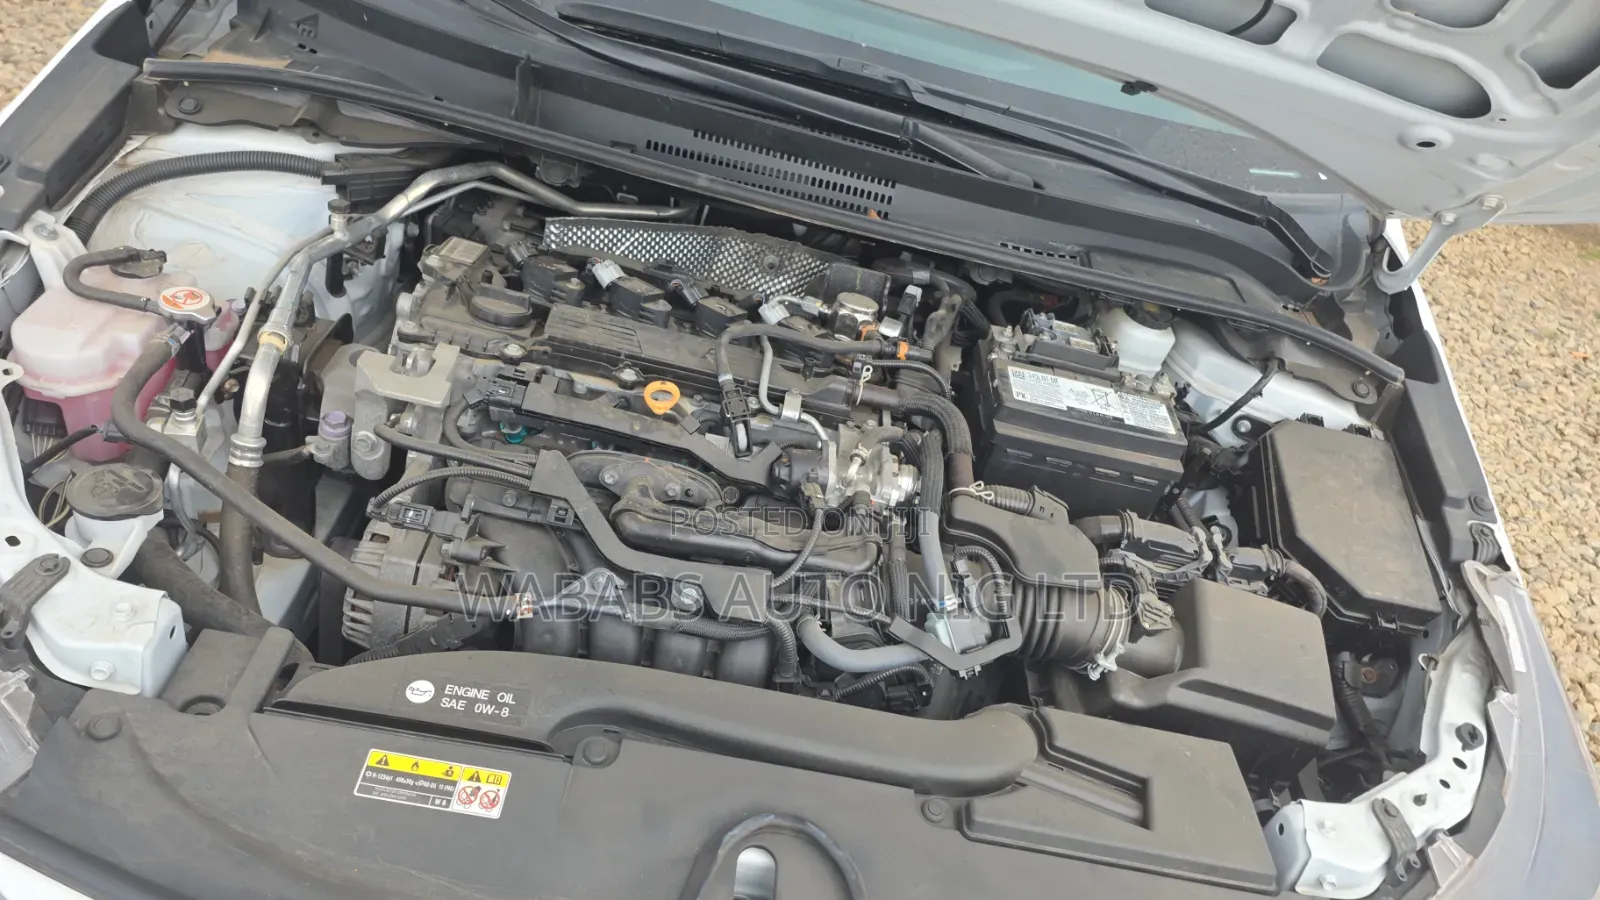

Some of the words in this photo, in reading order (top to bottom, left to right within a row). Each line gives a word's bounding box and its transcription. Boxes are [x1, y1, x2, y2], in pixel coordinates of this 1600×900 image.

[444, 684, 491, 700] ENGINE
[497, 692, 516, 704] OIL
[440, 697, 467, 711] SAE
[474, 703, 510, 717] 0W-8
